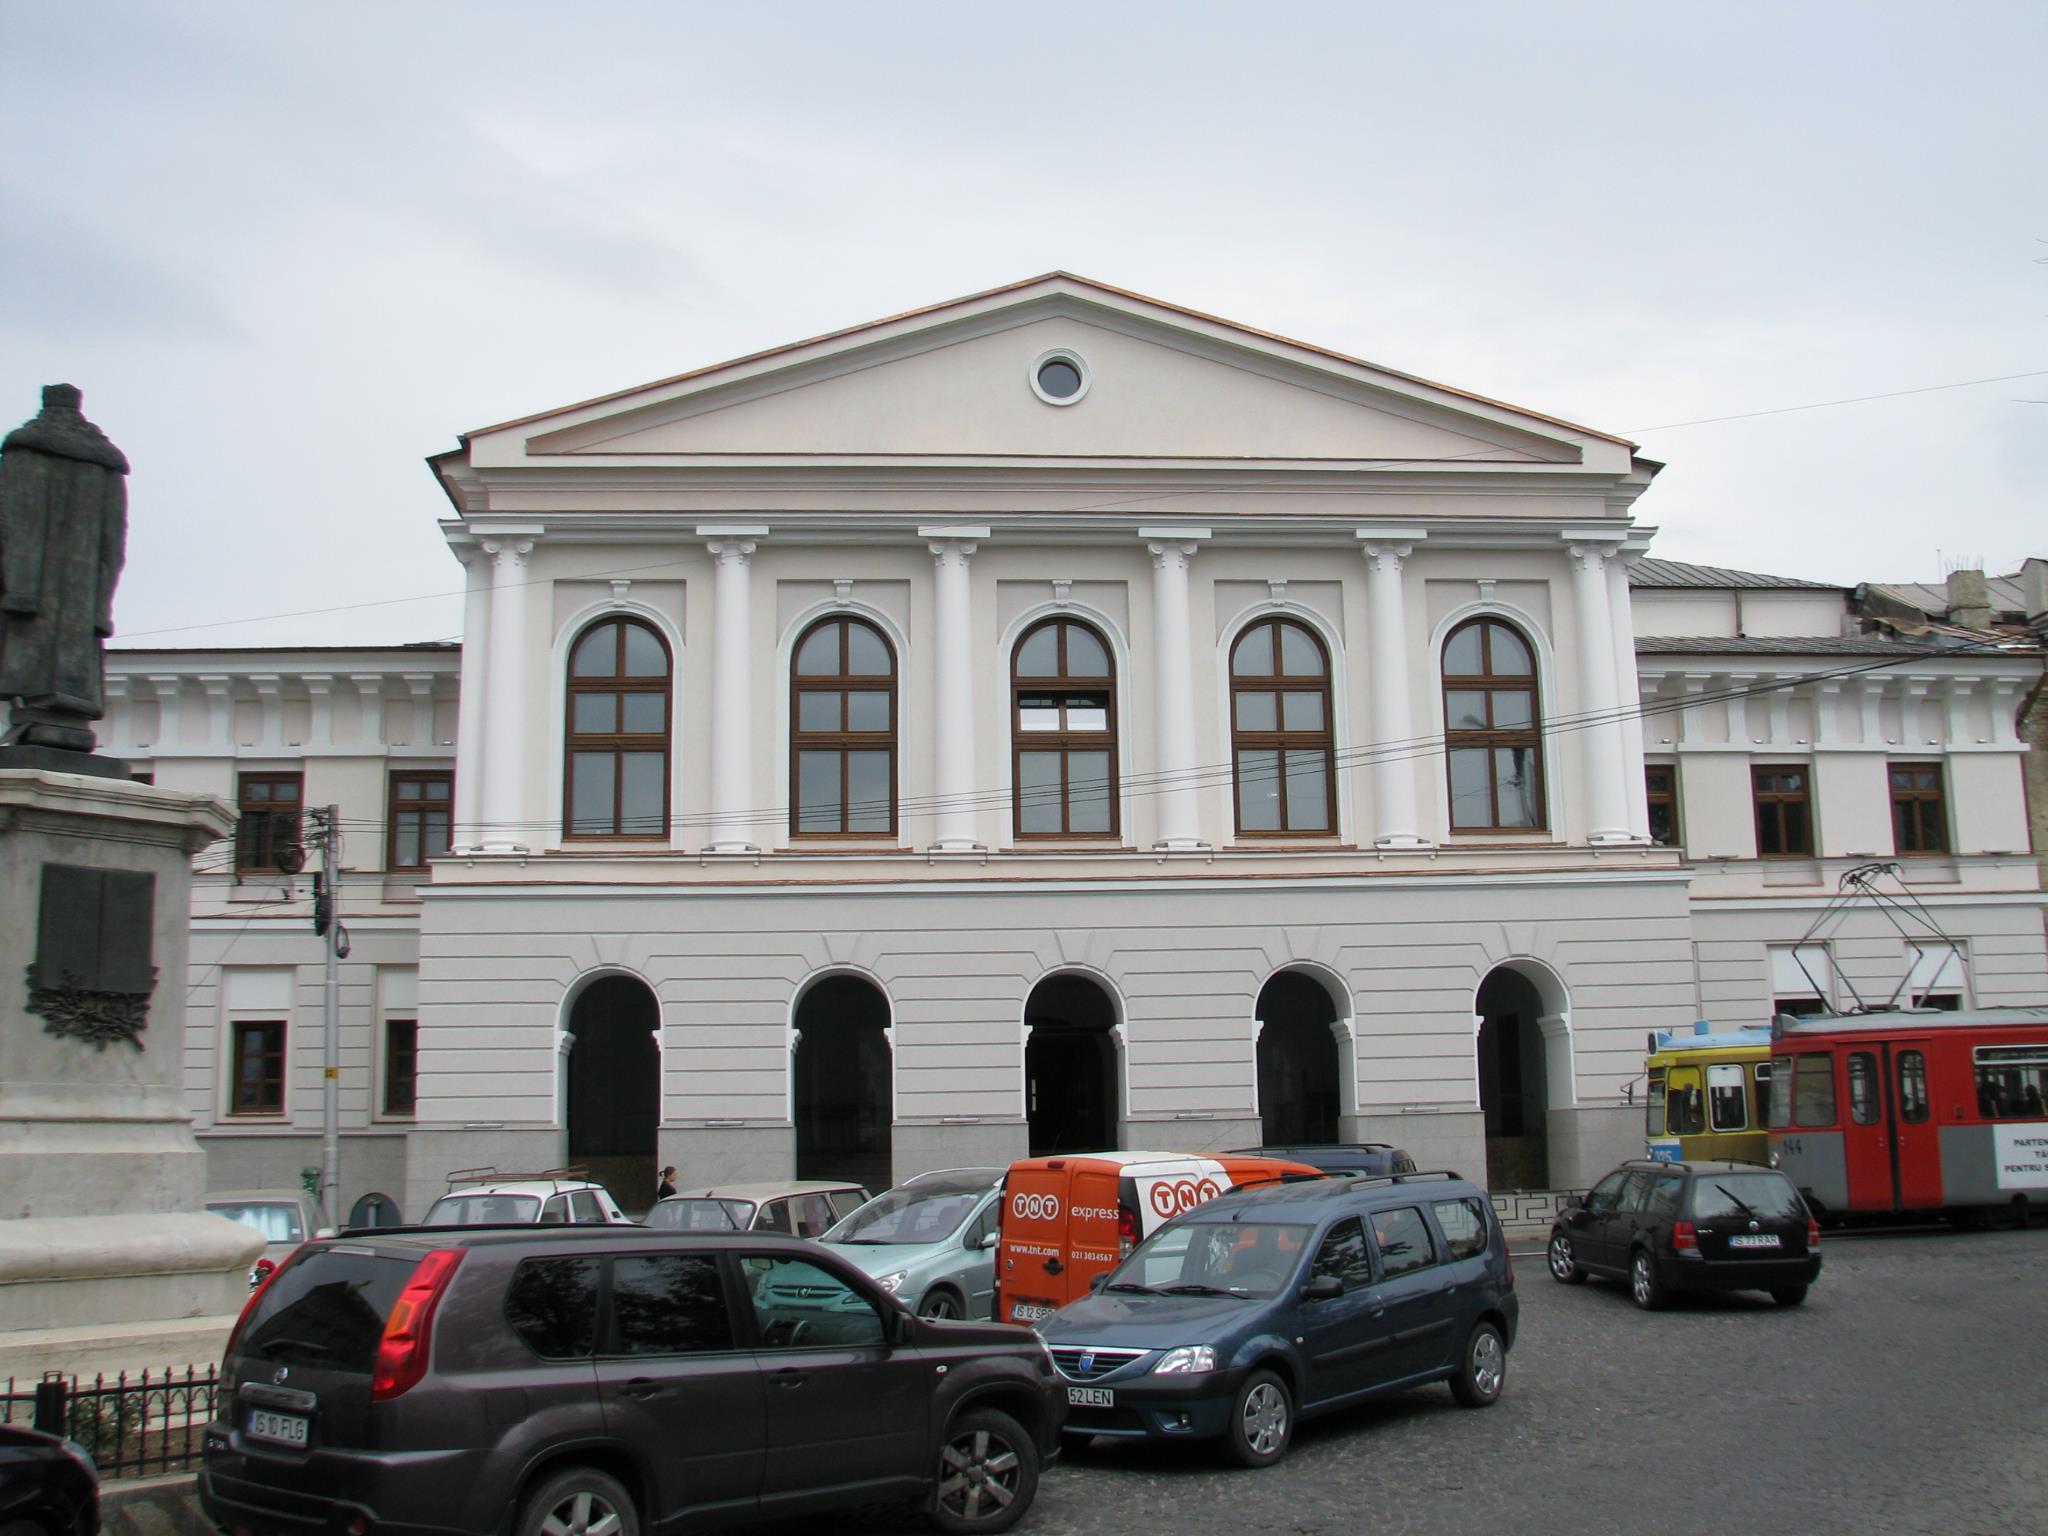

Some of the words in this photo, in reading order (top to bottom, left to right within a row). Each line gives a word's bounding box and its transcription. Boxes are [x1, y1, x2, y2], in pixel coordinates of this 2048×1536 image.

[1154, 1185, 1217, 1211] TNT
[1015, 1197, 1056, 1215] TNT
[1071, 1206, 1119, 1221] express
[1009, 1244, 1060, 1257] www.tnt.com
[1071, 1250, 1083, 1260] 021
[1070, 1389, 1083, 1403] 52
[1086, 1389, 1111, 1405] LEN
[281, 1417, 305, 1441] FLG
